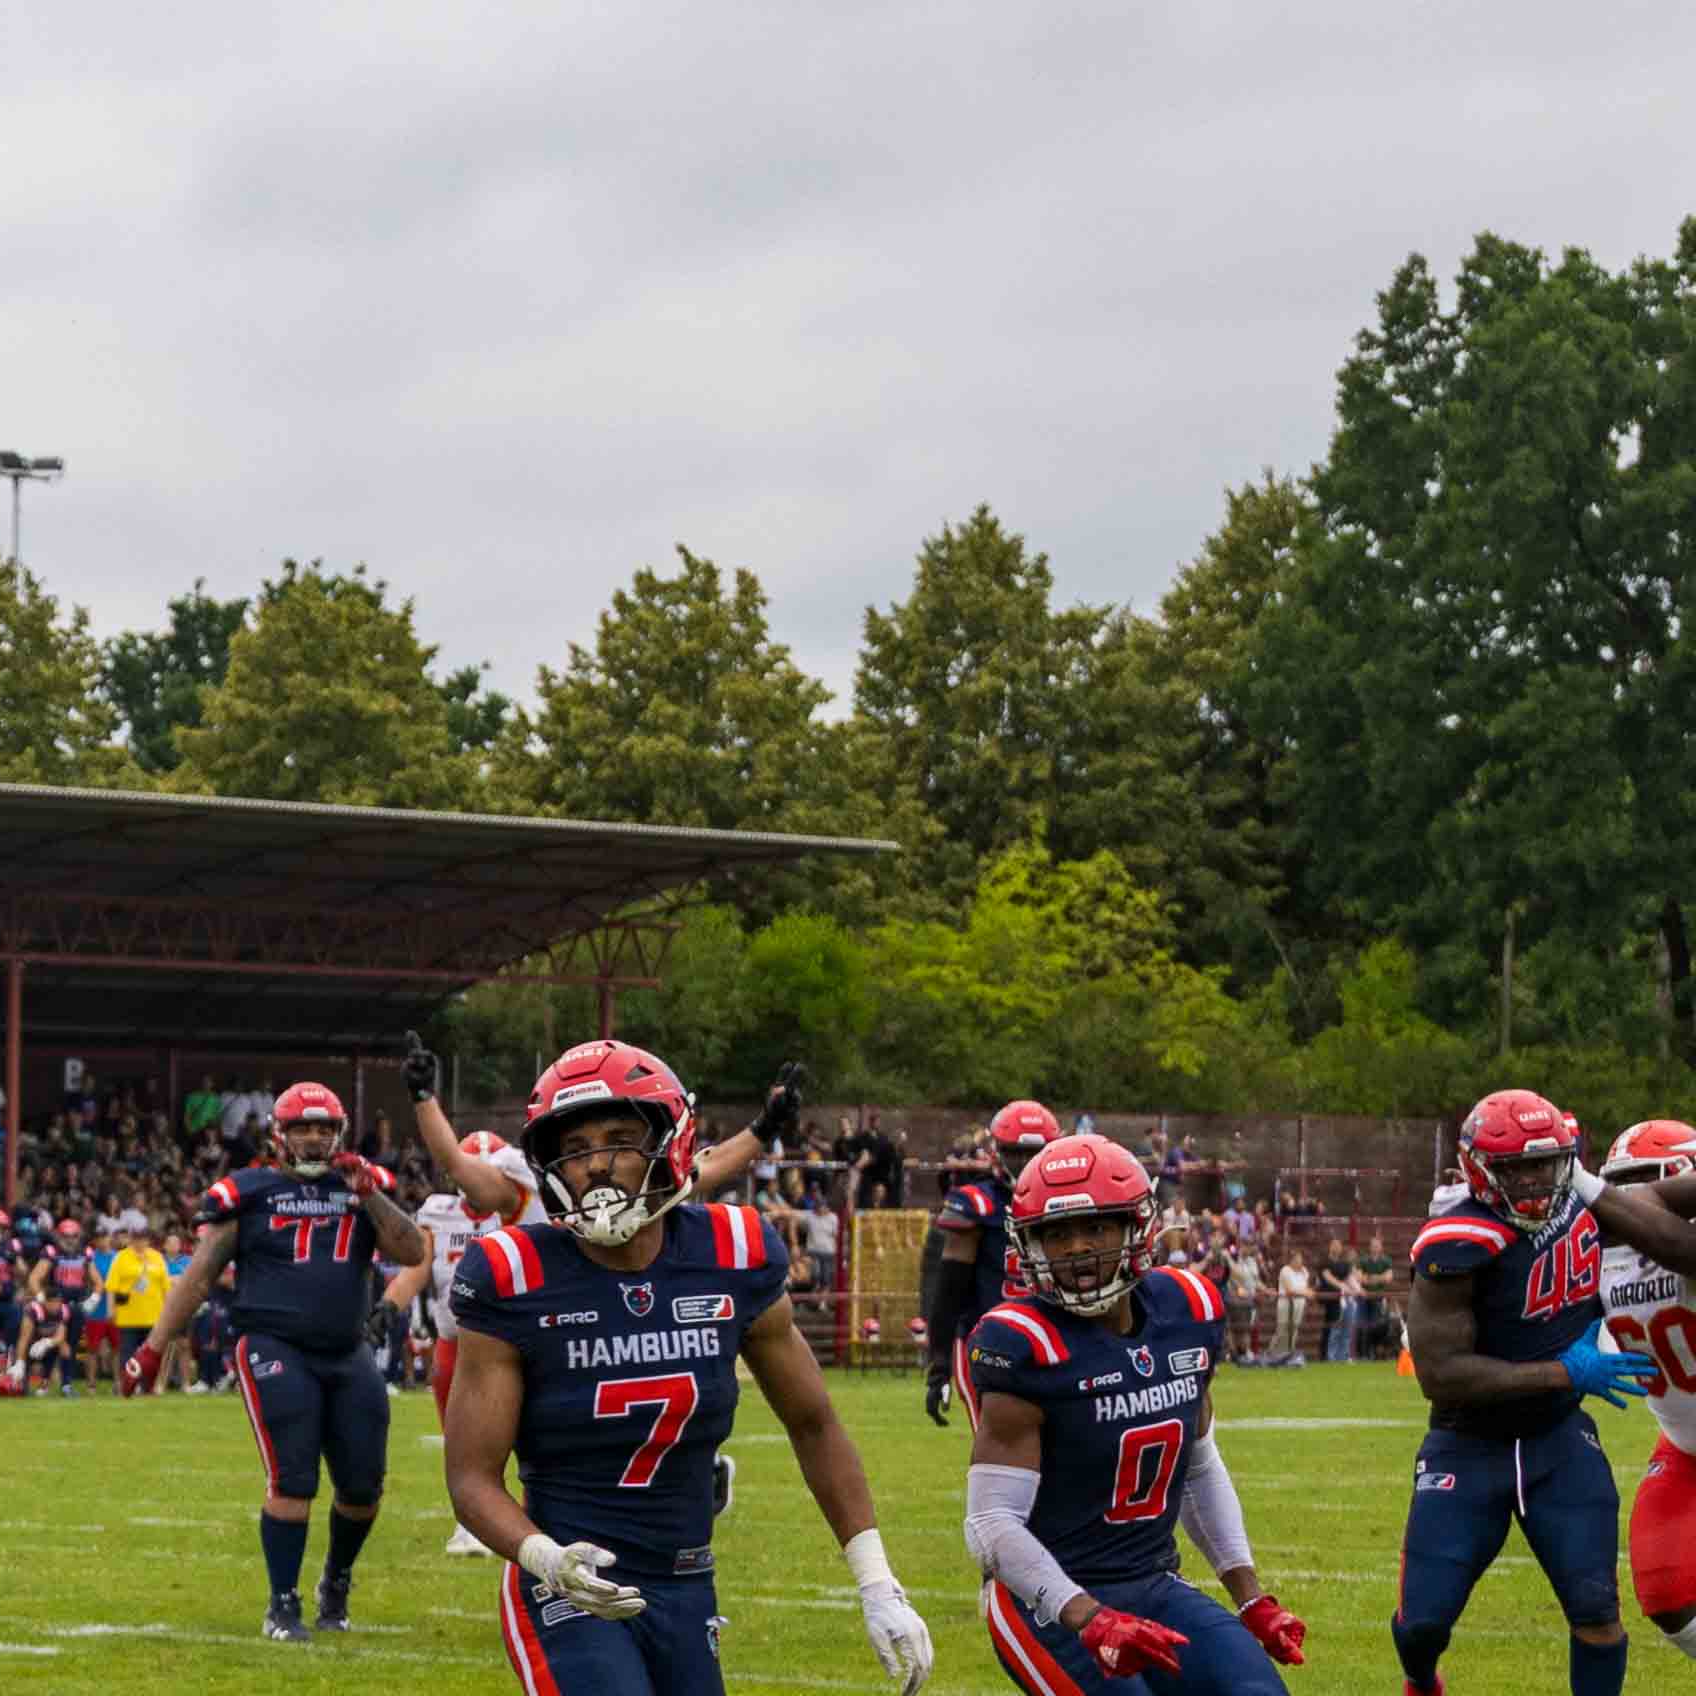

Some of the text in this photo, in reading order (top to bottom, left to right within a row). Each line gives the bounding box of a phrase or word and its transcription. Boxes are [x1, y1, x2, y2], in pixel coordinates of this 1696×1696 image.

[276, 1200, 347, 1214] HAMBURG
[270, 1215, 356, 1263] 77
[1521, 1207, 1600, 1322] 45
[1610, 1275, 1676, 1307] MADRID
[567, 1328, 720, 1369] HAMBURG
[1095, 1375, 1198, 1423] HAMBURG
[593, 1371, 699, 1487] 7
[1104, 1418, 1183, 1524] 0
